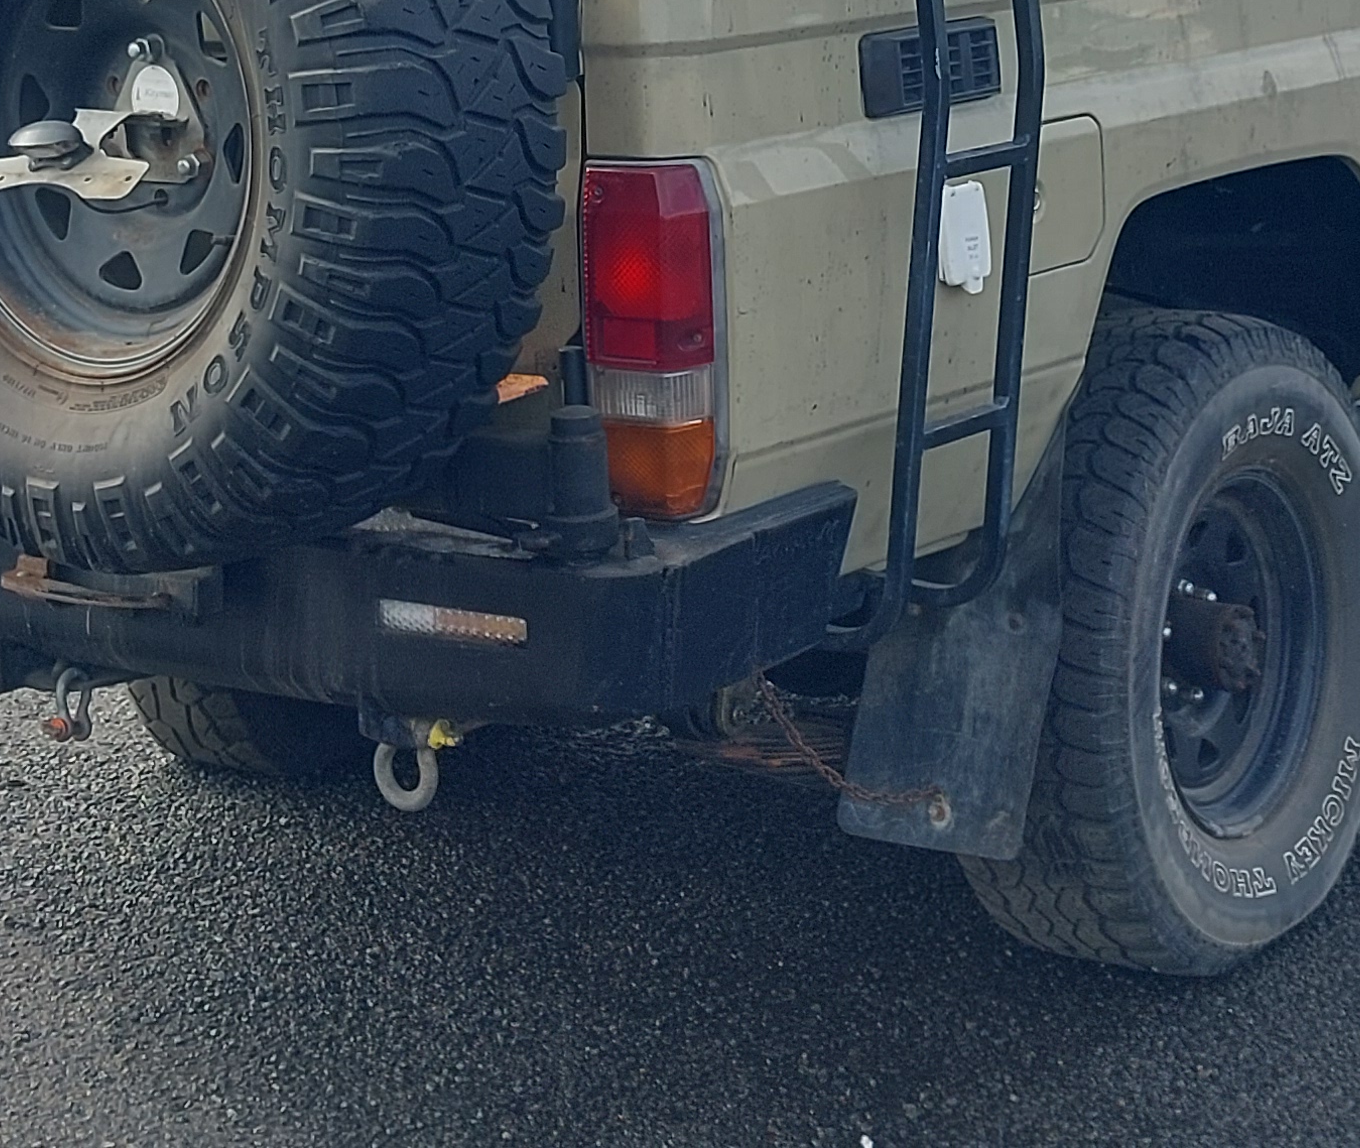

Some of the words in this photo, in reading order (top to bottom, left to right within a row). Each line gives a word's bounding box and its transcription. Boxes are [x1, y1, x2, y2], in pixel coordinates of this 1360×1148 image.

[170, 27, 286, 437] THOMPSON
[1222, 407, 1295, 461] BAJA
[1301, 422, 1353, 495] ATZ
